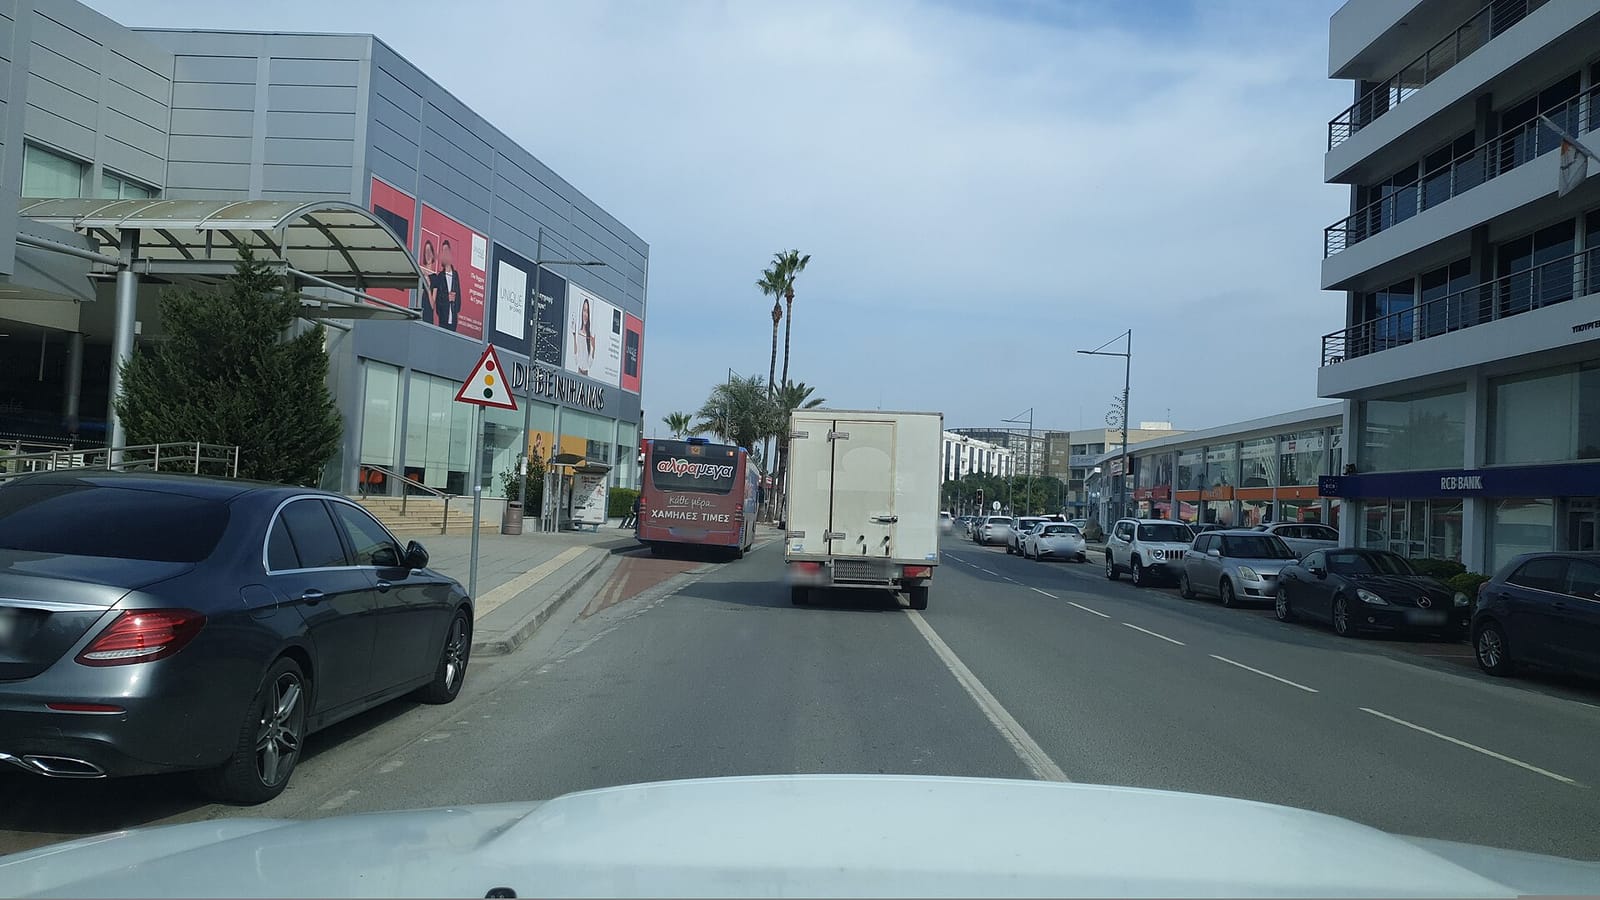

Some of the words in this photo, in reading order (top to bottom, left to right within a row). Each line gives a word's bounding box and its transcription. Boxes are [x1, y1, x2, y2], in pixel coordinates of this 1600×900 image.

[1440, 477, 1457, 490] RCB
[1458, 476, 1482, 489] BANK
[651, 509, 698, 521] ΧΑΜΗΛΕΣ
[702, 514, 730, 523] ΤΙΜΕΣ
